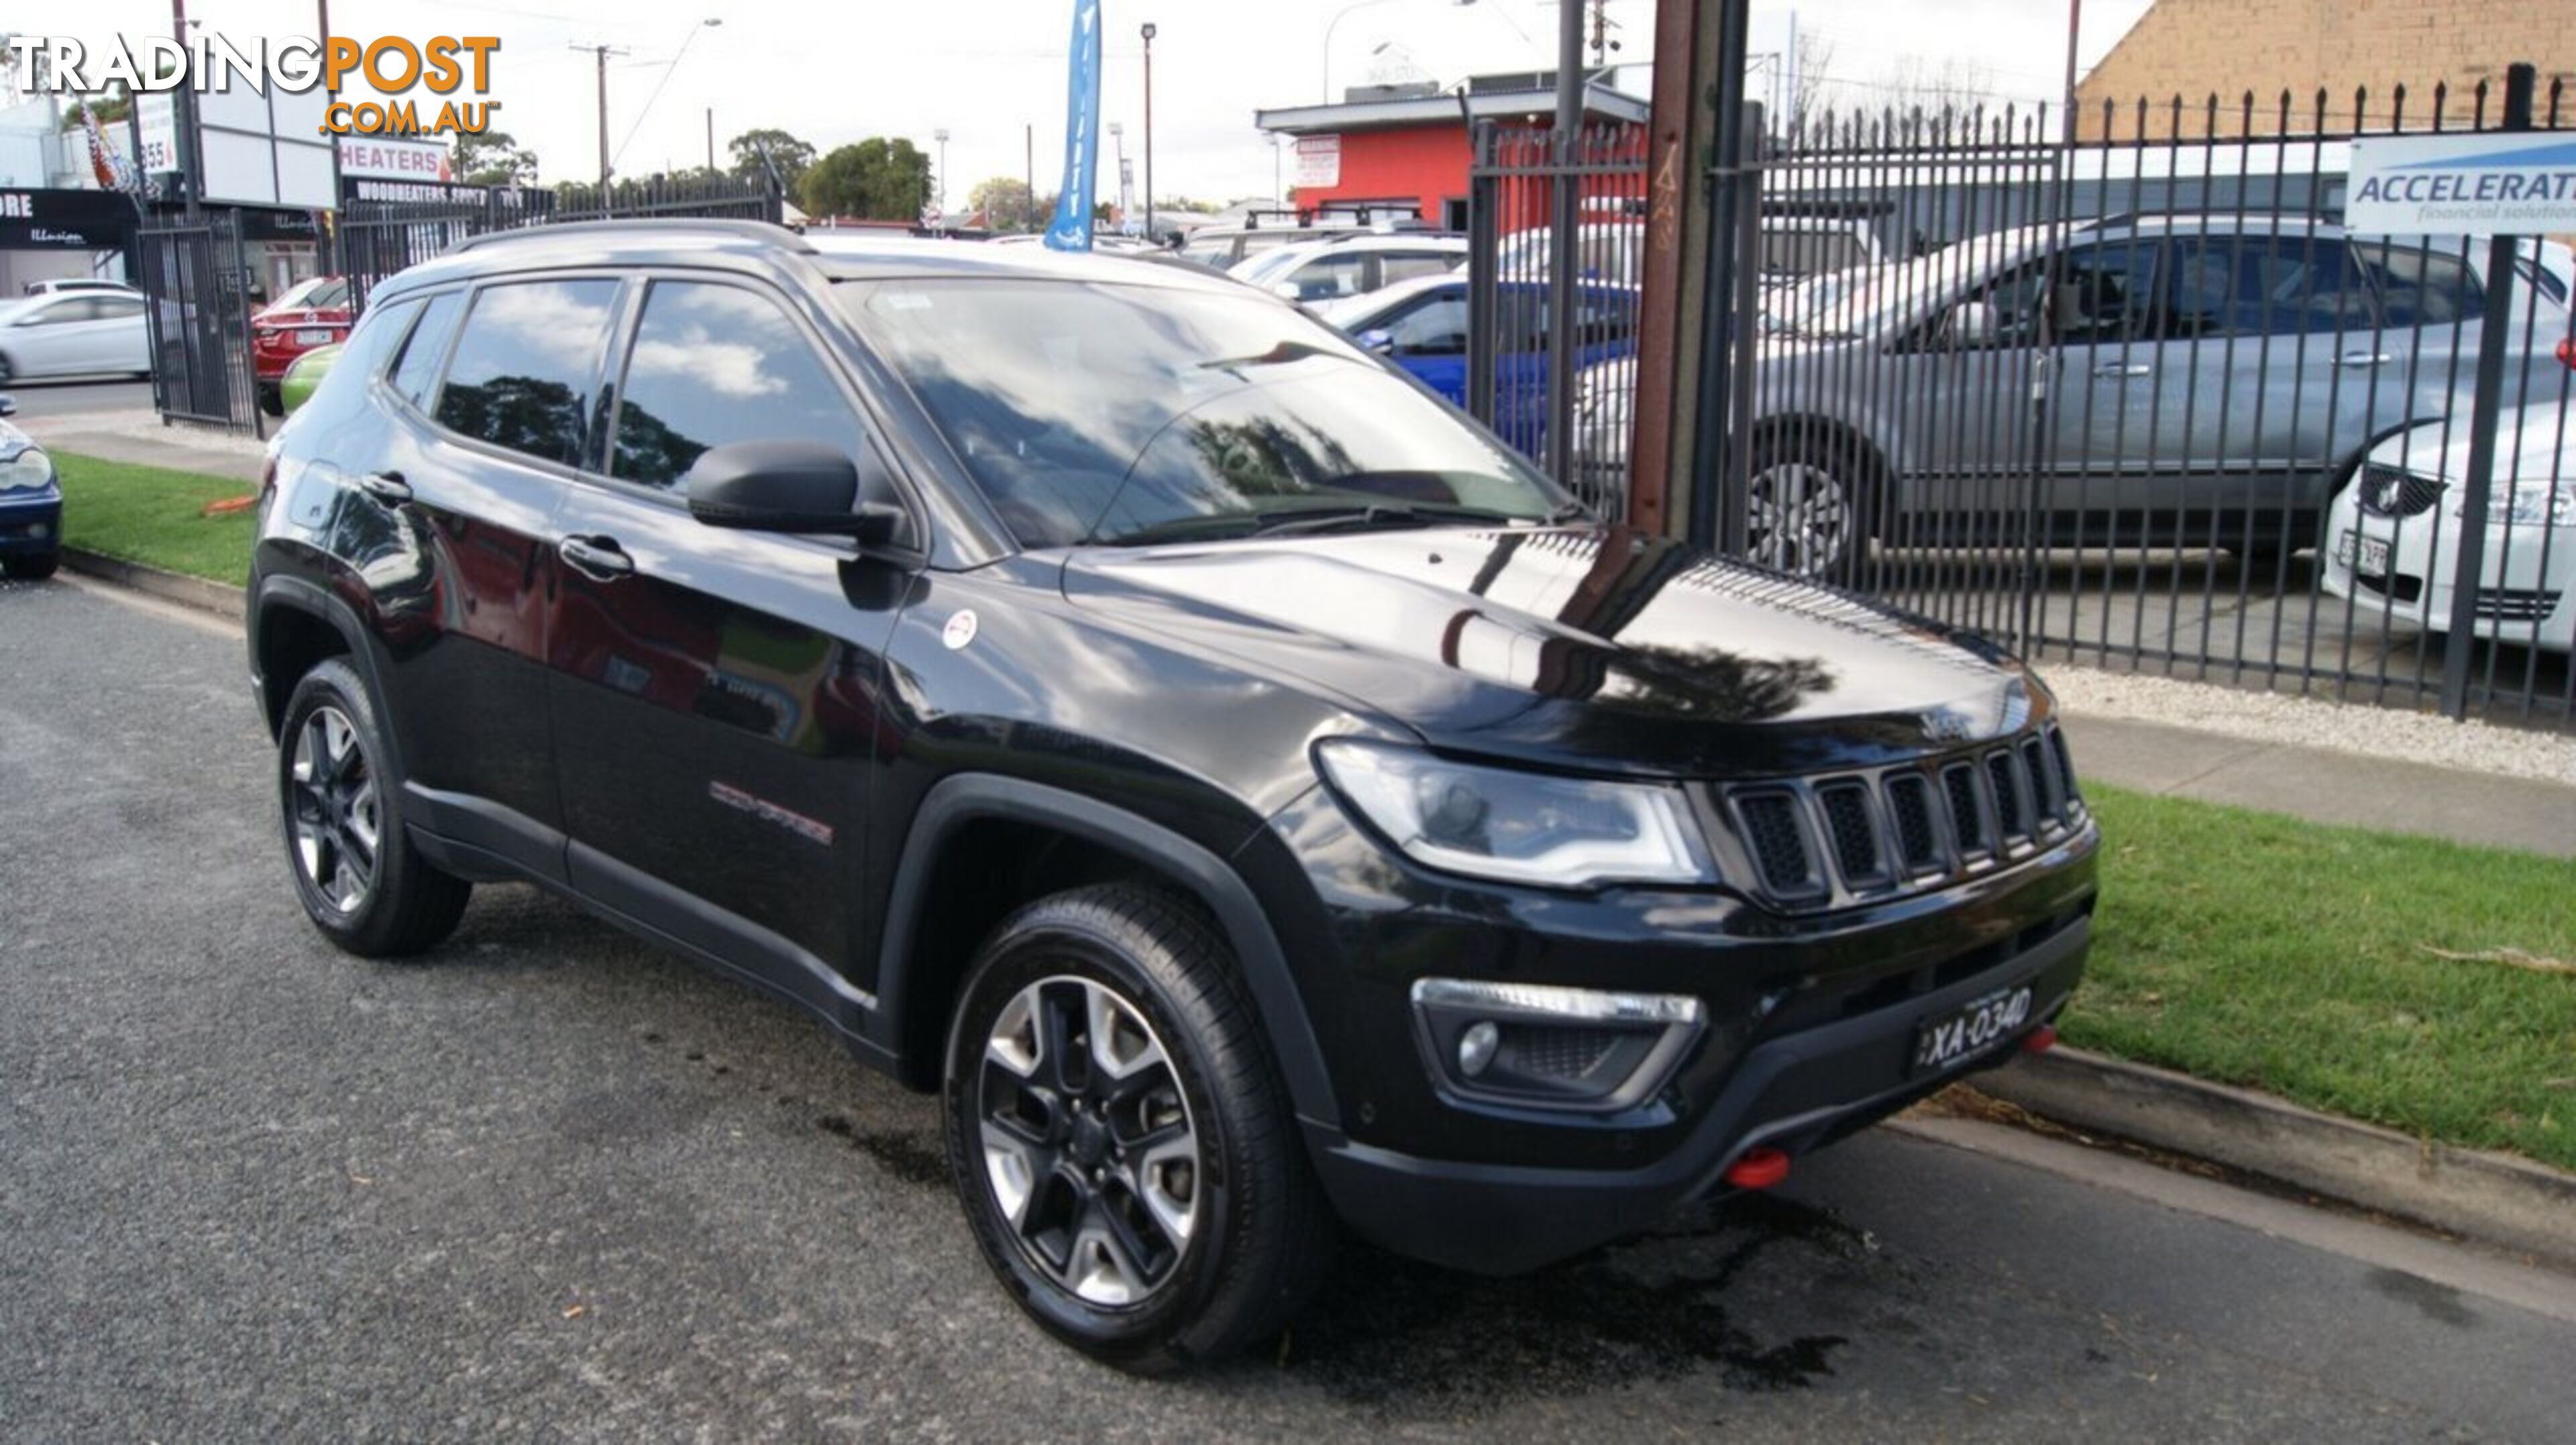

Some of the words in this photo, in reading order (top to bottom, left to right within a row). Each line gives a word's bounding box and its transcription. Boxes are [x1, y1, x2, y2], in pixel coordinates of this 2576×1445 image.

[339, 143, 437, 172] HEATERS
[2356, 172, 2576, 203] ACCELERAT
[2416, 203, 2500, 223] financial
